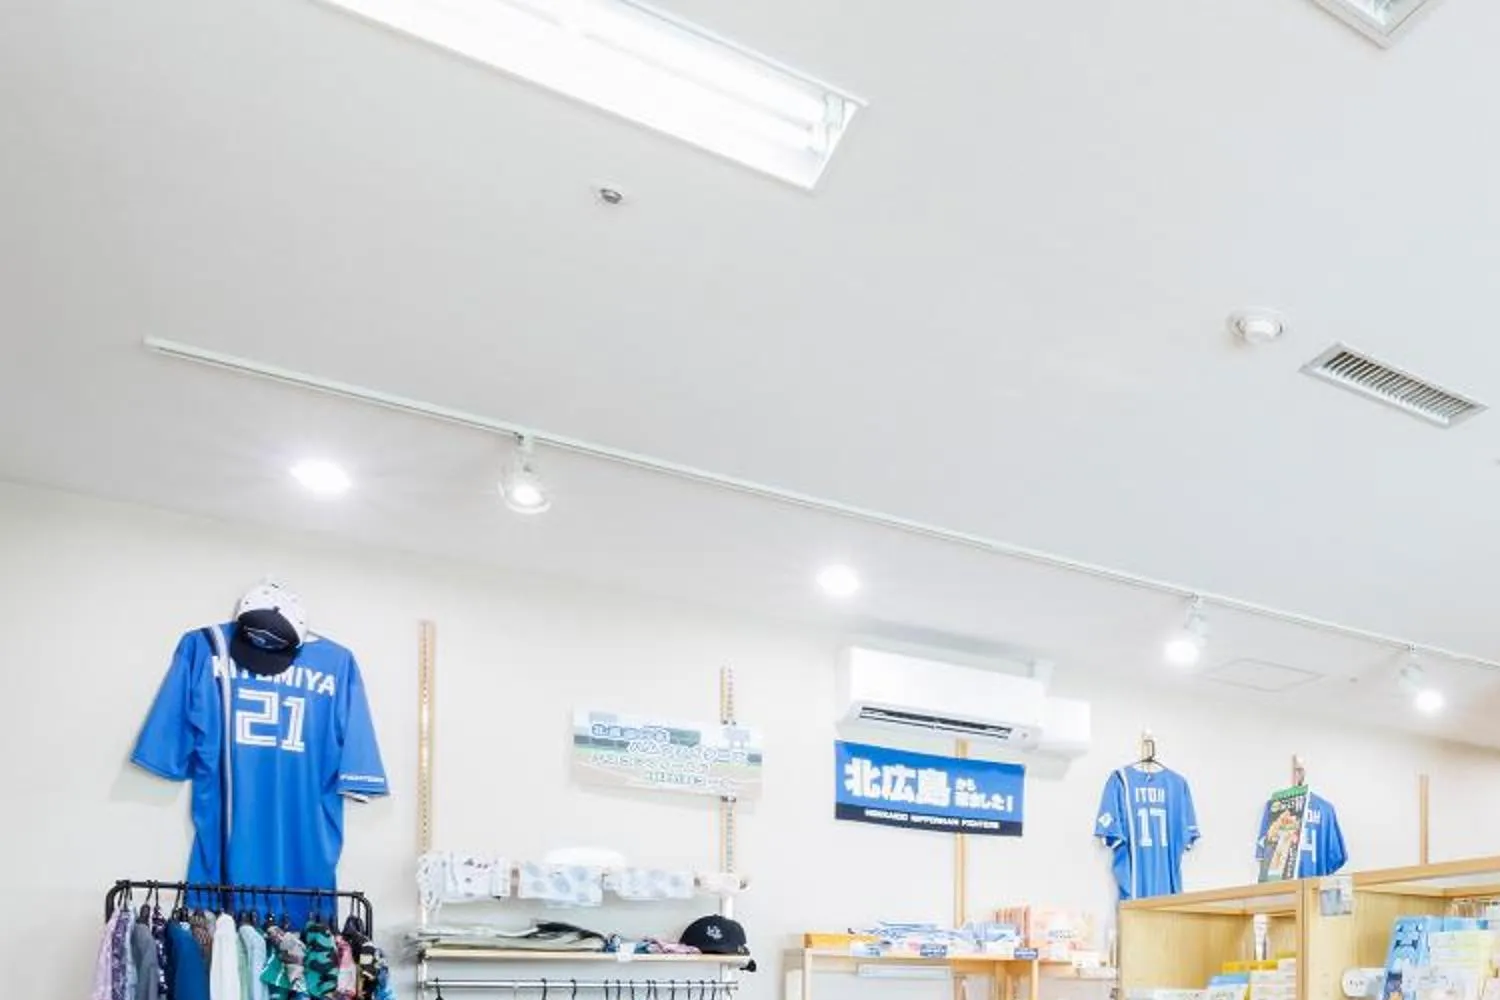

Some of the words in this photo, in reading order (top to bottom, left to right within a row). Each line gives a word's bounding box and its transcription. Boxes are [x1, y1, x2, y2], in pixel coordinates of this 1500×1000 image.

[212, 656, 336, 696] KIMIYA
[236, 688, 305, 752] 21
[844, 757, 950, 806] 北広島
[1135, 787, 1165, 803] ITOH
[1137, 808, 1168, 847] 17
